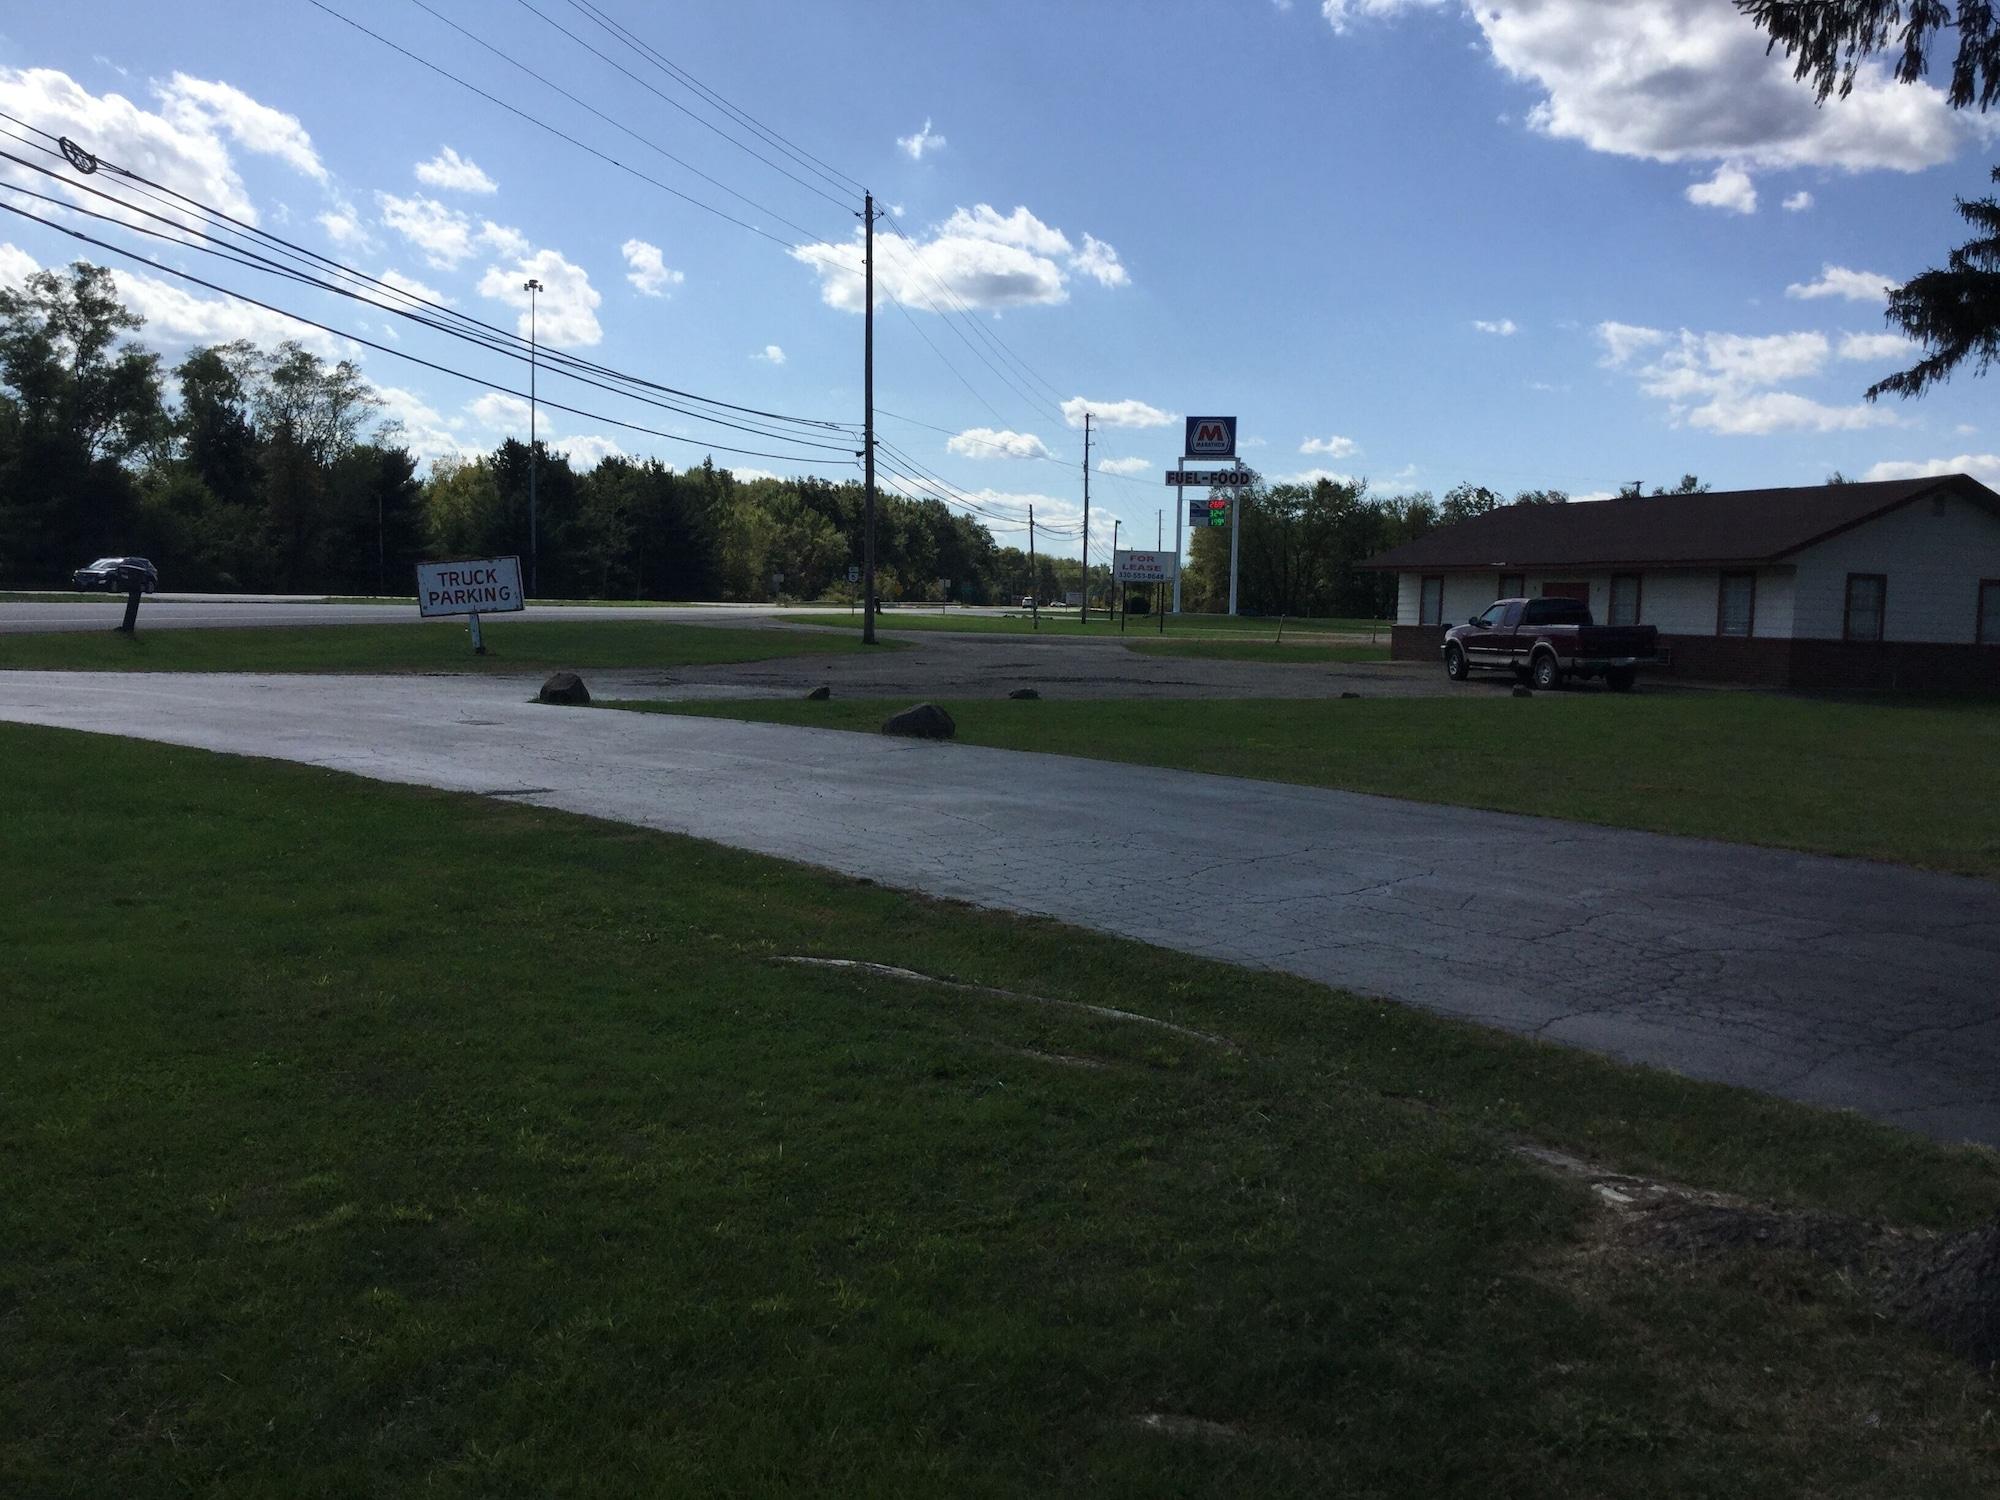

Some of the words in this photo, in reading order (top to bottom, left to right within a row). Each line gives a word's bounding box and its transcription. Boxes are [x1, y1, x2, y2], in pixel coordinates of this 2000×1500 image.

[1197, 425, 1224, 441] M
[1167, 472, 1249, 485] FUEL-FOOD
[1122, 564, 1161, 572] LEASE
[437, 568, 498, 587] TRUCK
[429, 586, 511, 606] PARKING
